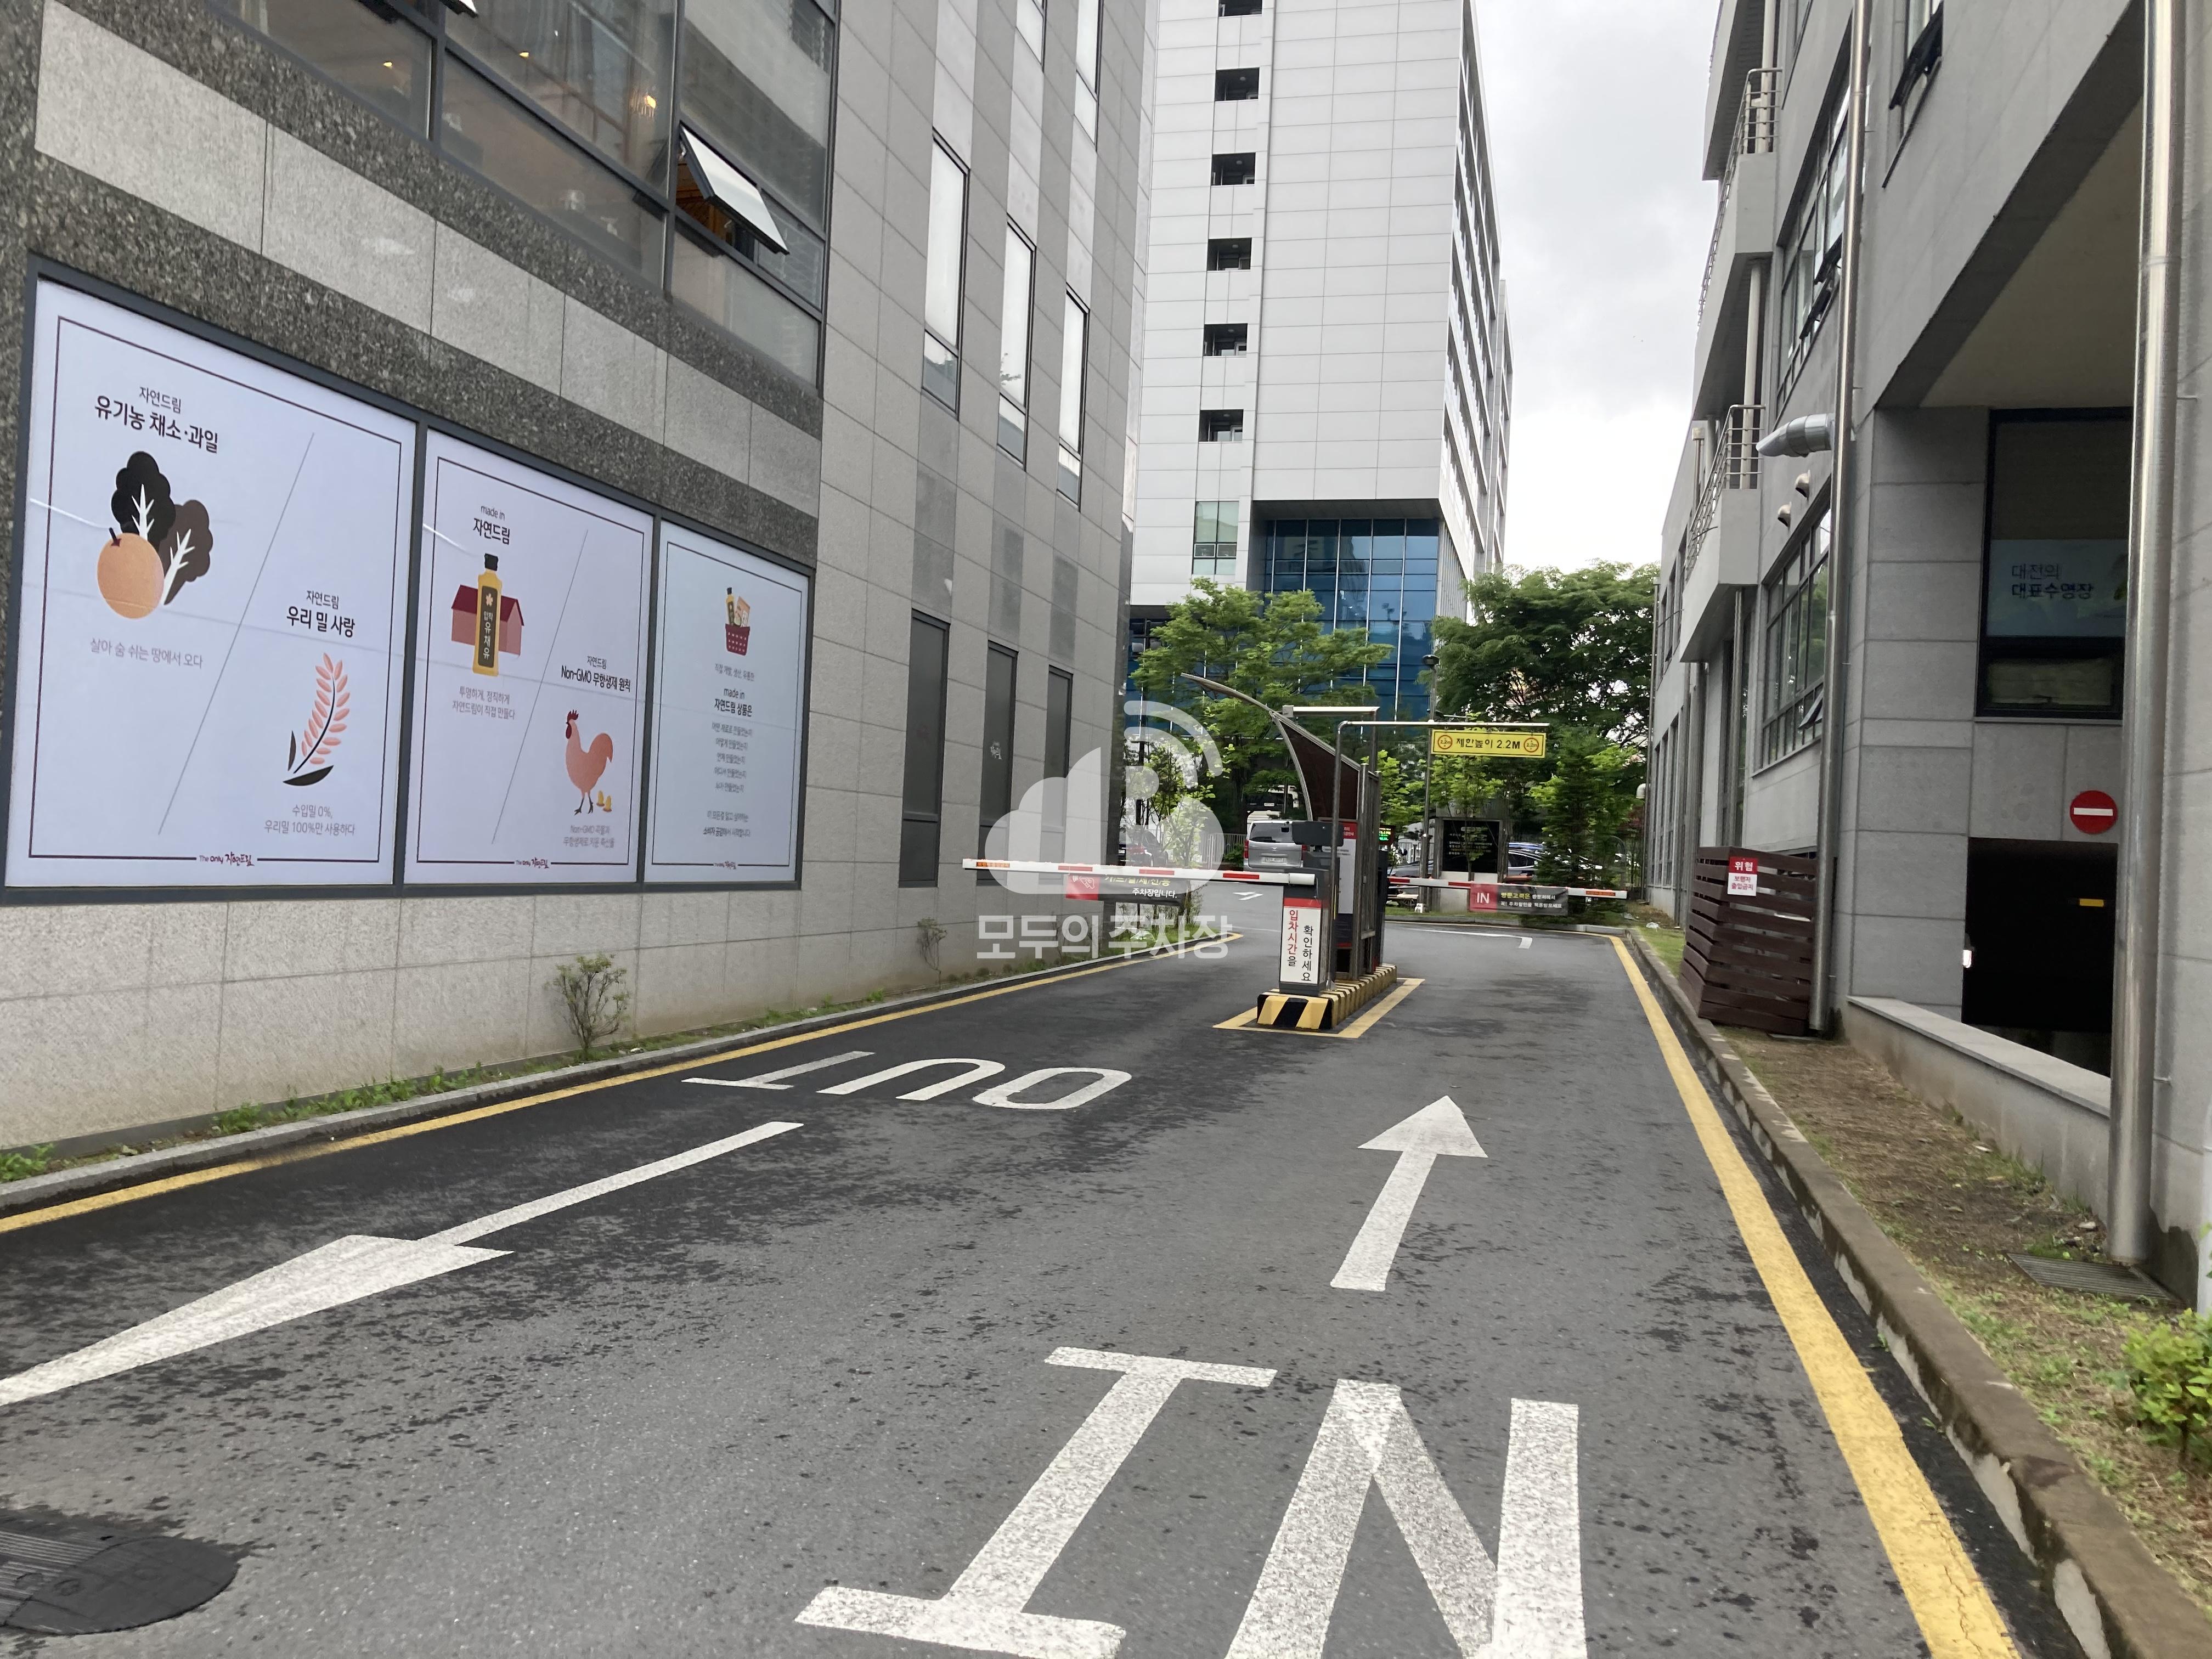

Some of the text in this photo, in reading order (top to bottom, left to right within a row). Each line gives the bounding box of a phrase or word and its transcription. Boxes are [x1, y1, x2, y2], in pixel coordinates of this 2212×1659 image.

[139, 386, 181, 414] 자연드림
[94, 396, 145, 430] 유기농
[481, 506, 505, 521] made in
[473, 517, 510, 545] 자연드림
[2012, 563, 2059, 580] 대전의
[306, 590, 339, 610] 자연드림
[2012, 583, 2094, 600] 대표수영장
[286, 606, 356, 638] 우리 밀 사랑
[483, 622, 491, 659] 유채유
[91, 637, 203, 669] 살아 숨 쉬는 땅에서 오다
[587, 656, 607, 669] 자연드림
[561, 665, 630, 692] Non-GMO 무항생제 원칙
[487, 691, 510, 705] 정직하게
[724, 688, 745, 699] made in
[485, 706, 496, 717] 직접
[714, 698, 752, 717] 자연드림 상품은
[1457, 738, 1493, 748] 제한높이
[1497, 740, 1520, 749] 2.2M
[292, 804, 317, 817] 수입밀
[264, 820, 356, 836] 우리밀 100%만 사용하다
[225, 851, 255, 866] 자연드림
[1735, 861, 1753, 872] 위험
[1132, 888, 1177, 899] 주차장입니다.
[1476, 892, 1490, 904] IN
[1301, 925, 1314, 981] 확인하세요
[681, 1051, 1132, 1110] OUT
[794, 1346, 1588, 1659] IN
